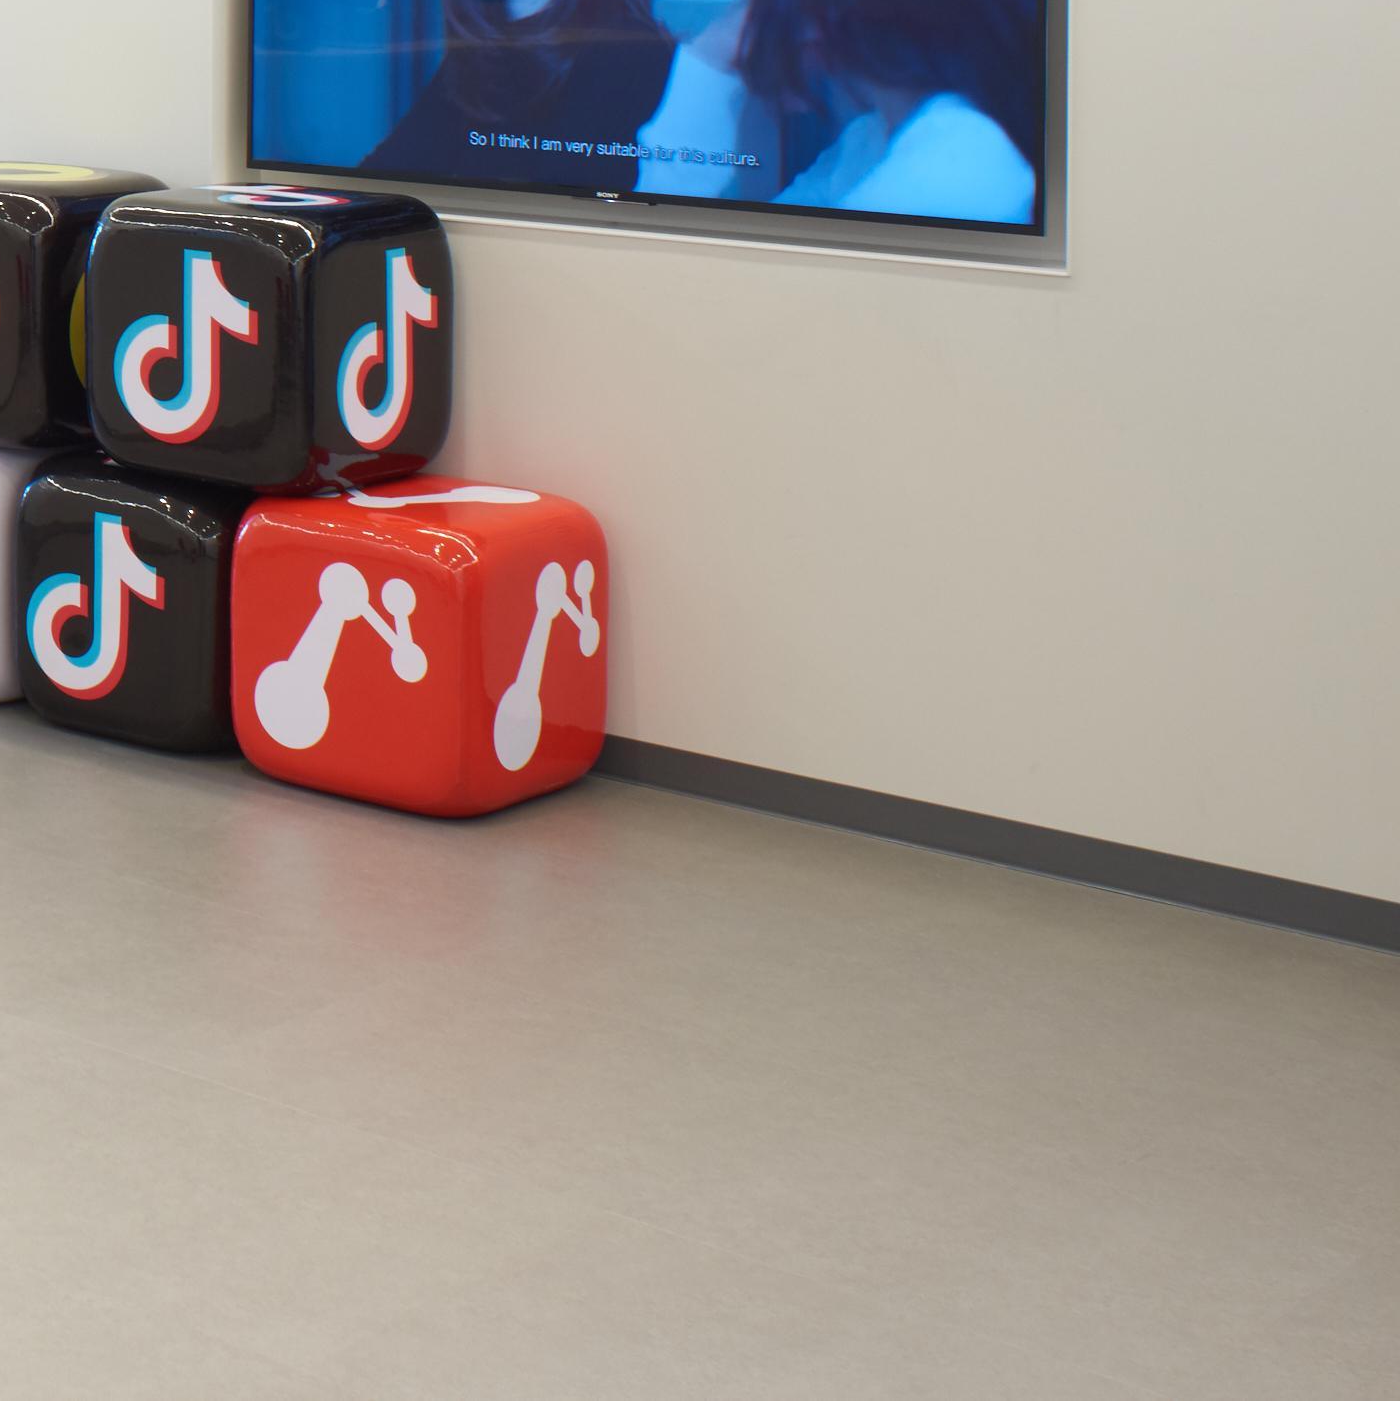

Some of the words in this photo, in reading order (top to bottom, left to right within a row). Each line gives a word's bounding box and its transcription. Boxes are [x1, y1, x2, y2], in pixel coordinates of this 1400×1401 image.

[469, 131, 488, 146] So
[497, 133, 530, 150] think
[541, 139, 562, 151] am
[564, 141, 594, 157] very
[596, 143, 650, 159] suitable
[655, 145, 673, 159] for
[679, 146, 704, 162] this
[707, 149, 760, 167] culture.
[596, 191, 620, 199] SONY
